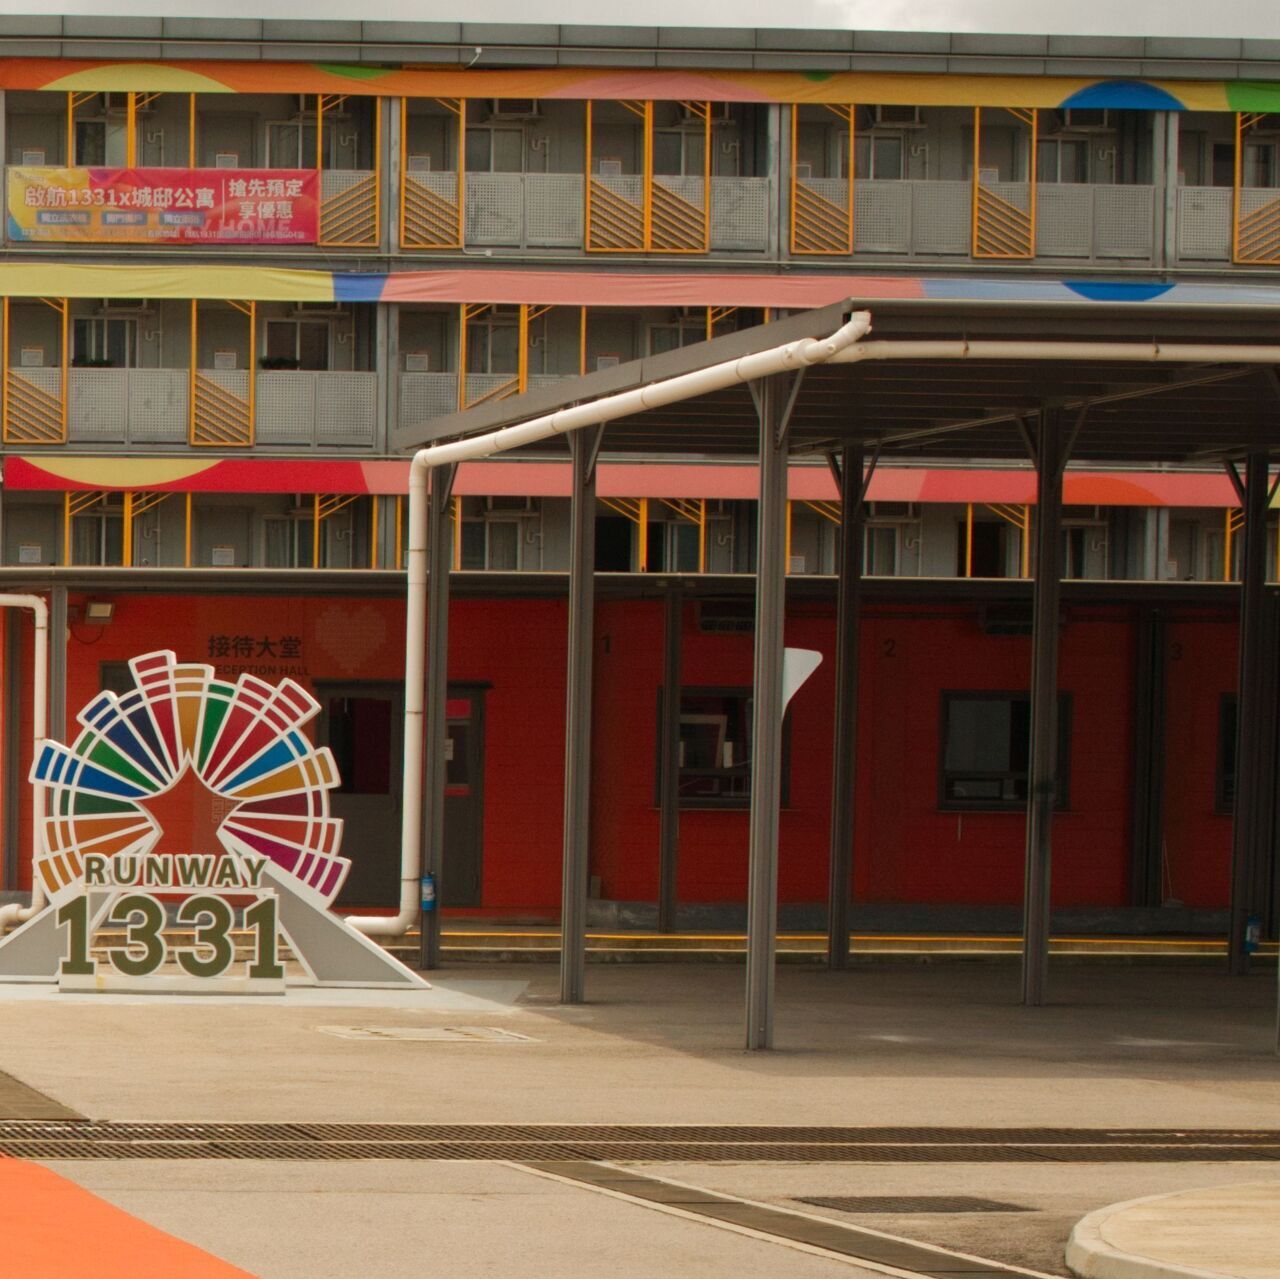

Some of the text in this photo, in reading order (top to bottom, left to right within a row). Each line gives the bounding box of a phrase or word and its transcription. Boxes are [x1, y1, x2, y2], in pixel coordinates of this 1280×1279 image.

[228, 179, 304, 197] 搶先預定
[238, 200, 294, 219] 享優惠
[207, 635, 301, 658] 接待大堂
[215, 664, 311, 676] ECEPTION HALL
[84, 855, 268, 888] RUNWAY
[57, 894, 286, 979] 1331
